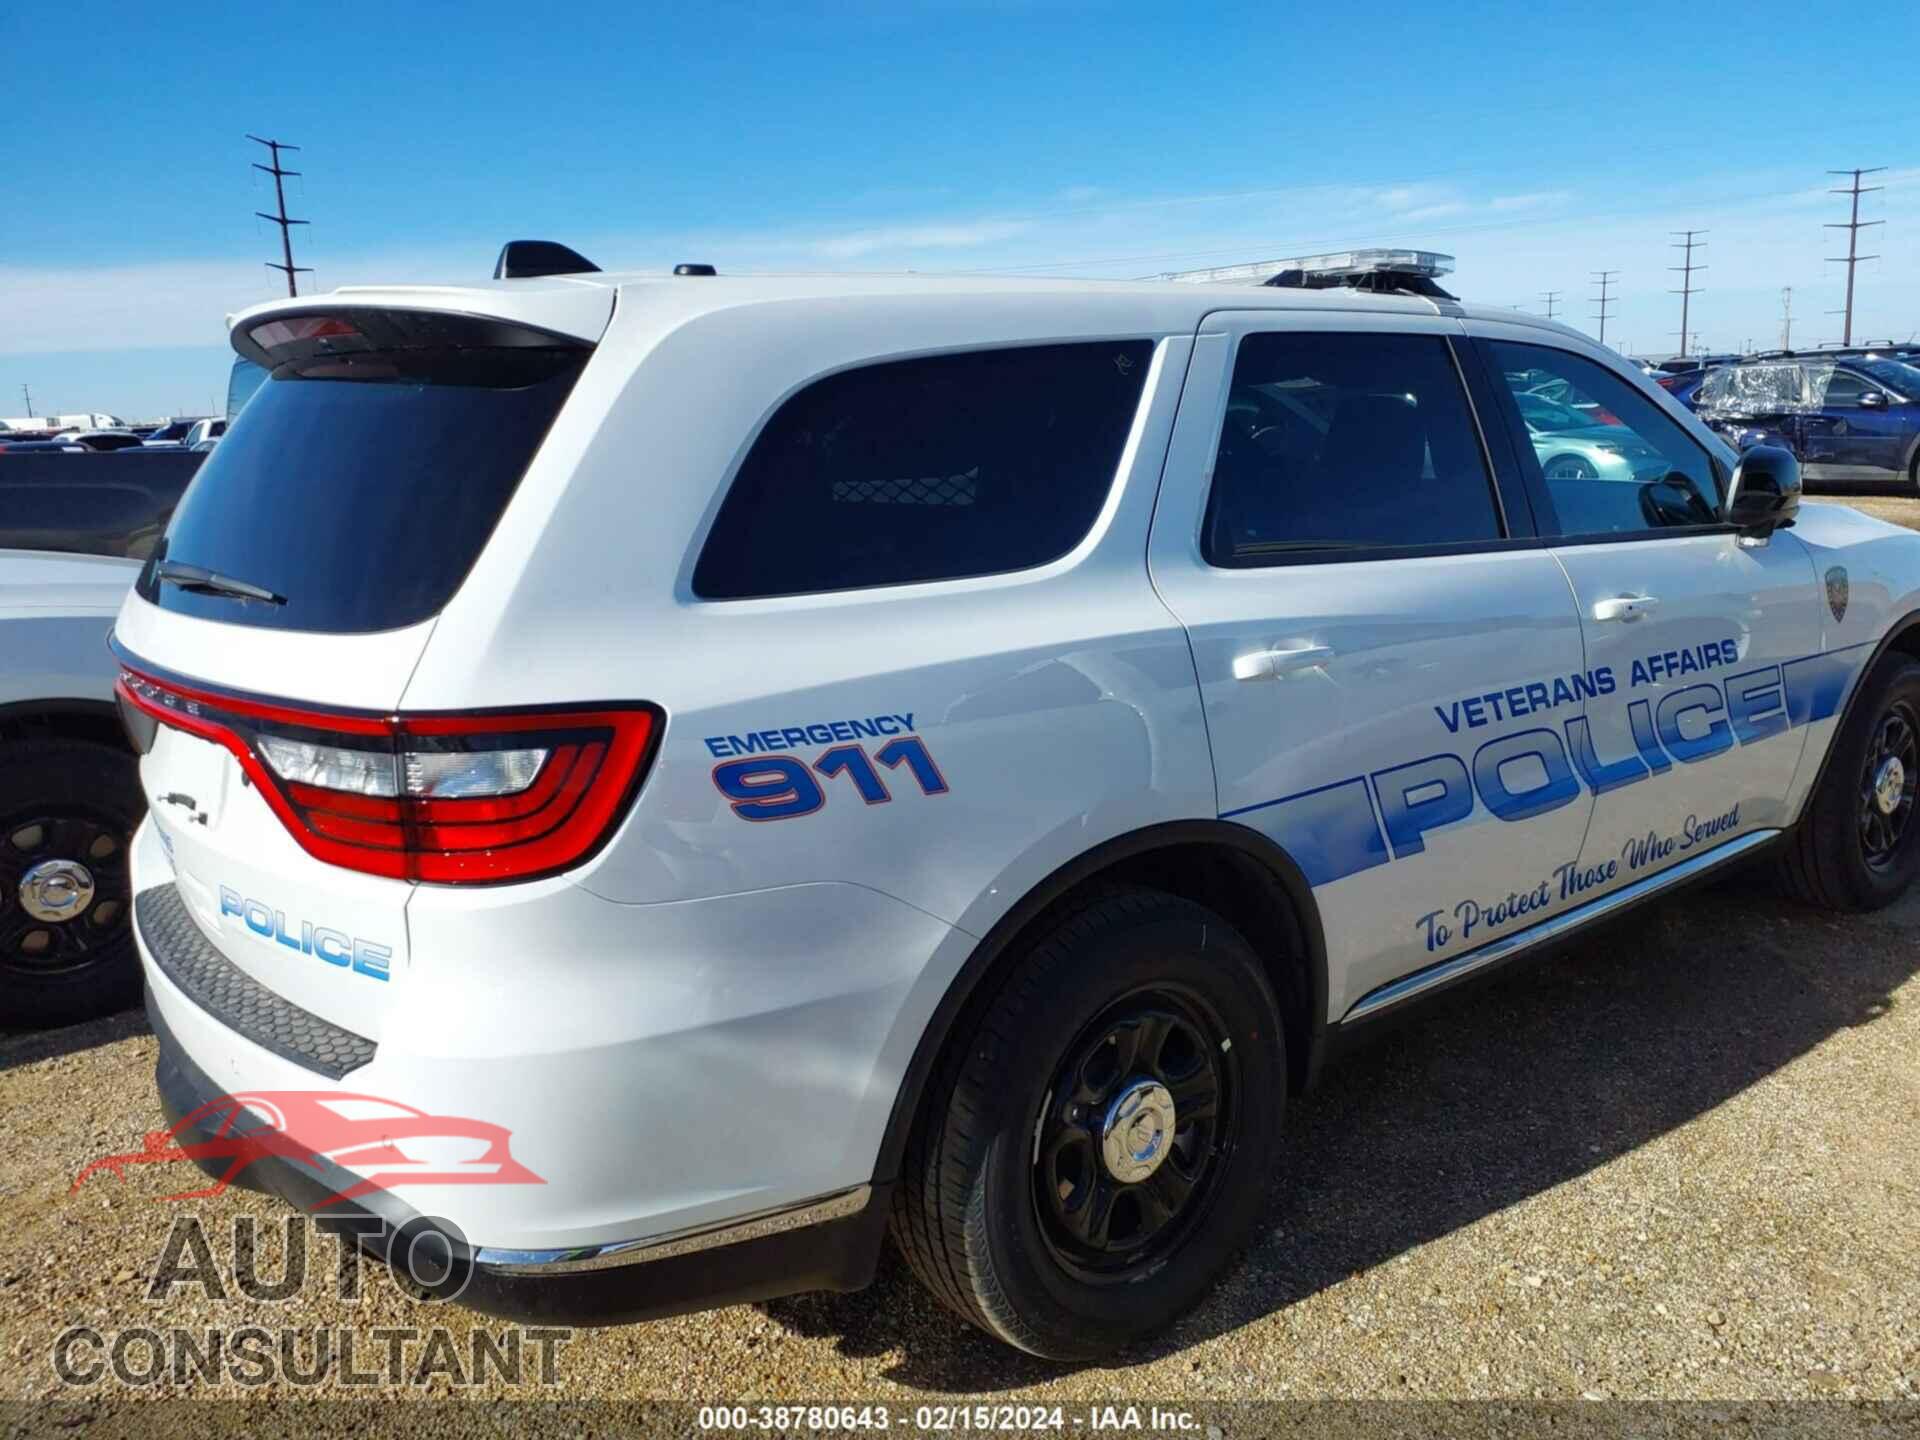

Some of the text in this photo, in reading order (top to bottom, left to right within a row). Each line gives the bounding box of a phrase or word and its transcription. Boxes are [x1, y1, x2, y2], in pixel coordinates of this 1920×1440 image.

[1435, 638, 1739, 733] VETERANS AFFAIRS
[704, 713, 915, 758] EMERGENCY
[711, 736, 950, 822] 911
[1371, 664, 1785, 860] POLICE
[1415, 802, 1740, 952] To Protect Those Who Served
[219, 884, 393, 983] POLICE
